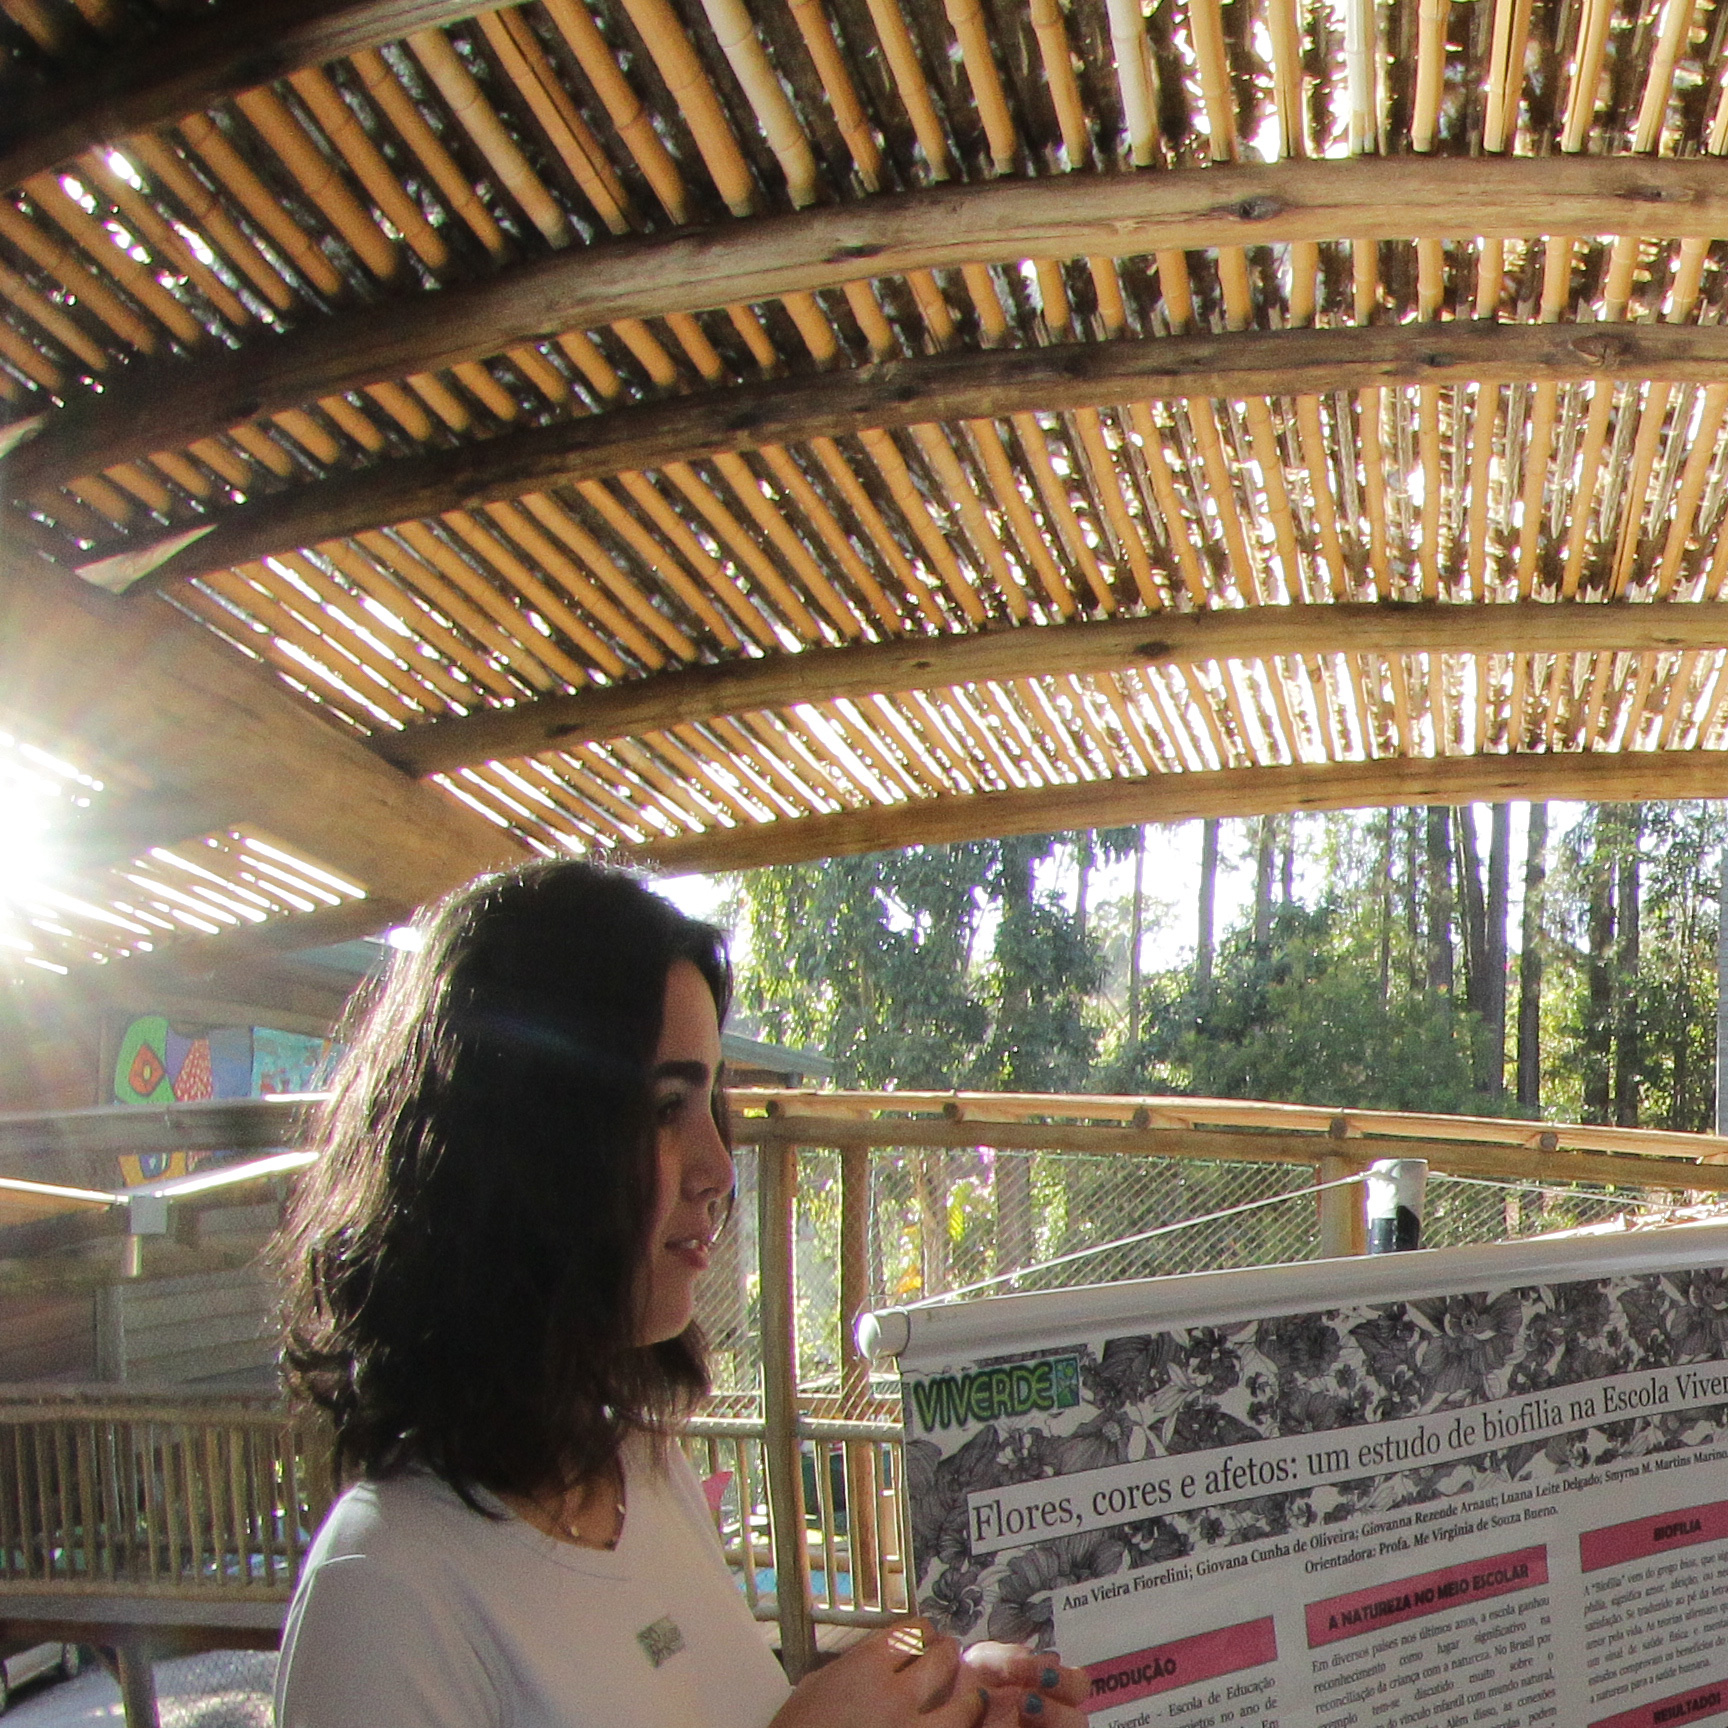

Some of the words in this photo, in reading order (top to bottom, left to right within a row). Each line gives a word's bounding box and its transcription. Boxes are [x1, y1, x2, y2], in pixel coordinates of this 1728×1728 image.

[912, 1360, 1055, 1433] VIVERDE
[970, 1498, 1082, 1541] Flores,
[1092, 1479, 1171, 1516] cores
[1180, 1475, 1195, 1498] e
[1205, 1456, 1297, 1494] afetos:
[1307, 1449, 1349, 1475] um
[1358, 1425, 1440, 1467] estudo
[1448, 1417, 1475, 1449] de
[1482, 1399, 1563, 1441] biofilia
[1569, 1398, 1596, 1421] na
[1602, 1377, 1669, 1413] Escola
[1062, 1594, 1089, 1611] Ana
[1090, 1582, 1131, 1603] Vieira
[1132, 1563, 1193, 1592] Fiorelini;
[1195, 1554, 1249, 1576] Giovana
[1250, 1543, 1291, 1563] Cunha
[1292, 1538, 1307, 1554] de
[1309, 1528, 1359, 1549] Oliveira;
[1360, 1516, 1412, 1537] Giovanna
[1414, 1503, 1458, 1525] Rezende
[1460, 1495, 1499, 1514] Arnaut;
[1500, 1489, 1533, 1505] Luana
[1535, 1482, 1561, 1498] Leite
[1562, 1472, 1603, 1492] Delgado;
[1604, 1466, 1640, 1483] Smyrna
[1641, 1461, 1653, 1474] M.
[1654, 1454, 1691, 1471] Martins
[1304, 1547, 1376, 1574] Orientadora:
[1378, 1536, 1411, 1556] Profa.
[1431, 1520, 1475, 1542] Virginia
[1475, 1516, 1489, 1532] de
[1490, 1512, 1522, 1528] Souza
[1523, 1505, 1558, 1521] Bueno.
[1652, 1518, 1702, 1542] BIOFILIA
[1327, 1614, 1340, 1632] A
[1339, 1593, 1413, 1628] NATUREZA
[1412, 1587, 1435, 1607] NO
[1436, 1578, 1470, 1601] MEIO
[1471, 1559, 1529, 1591] ESCOLAR
[1089, 1657, 1178, 1698] TRODUÇÃO
